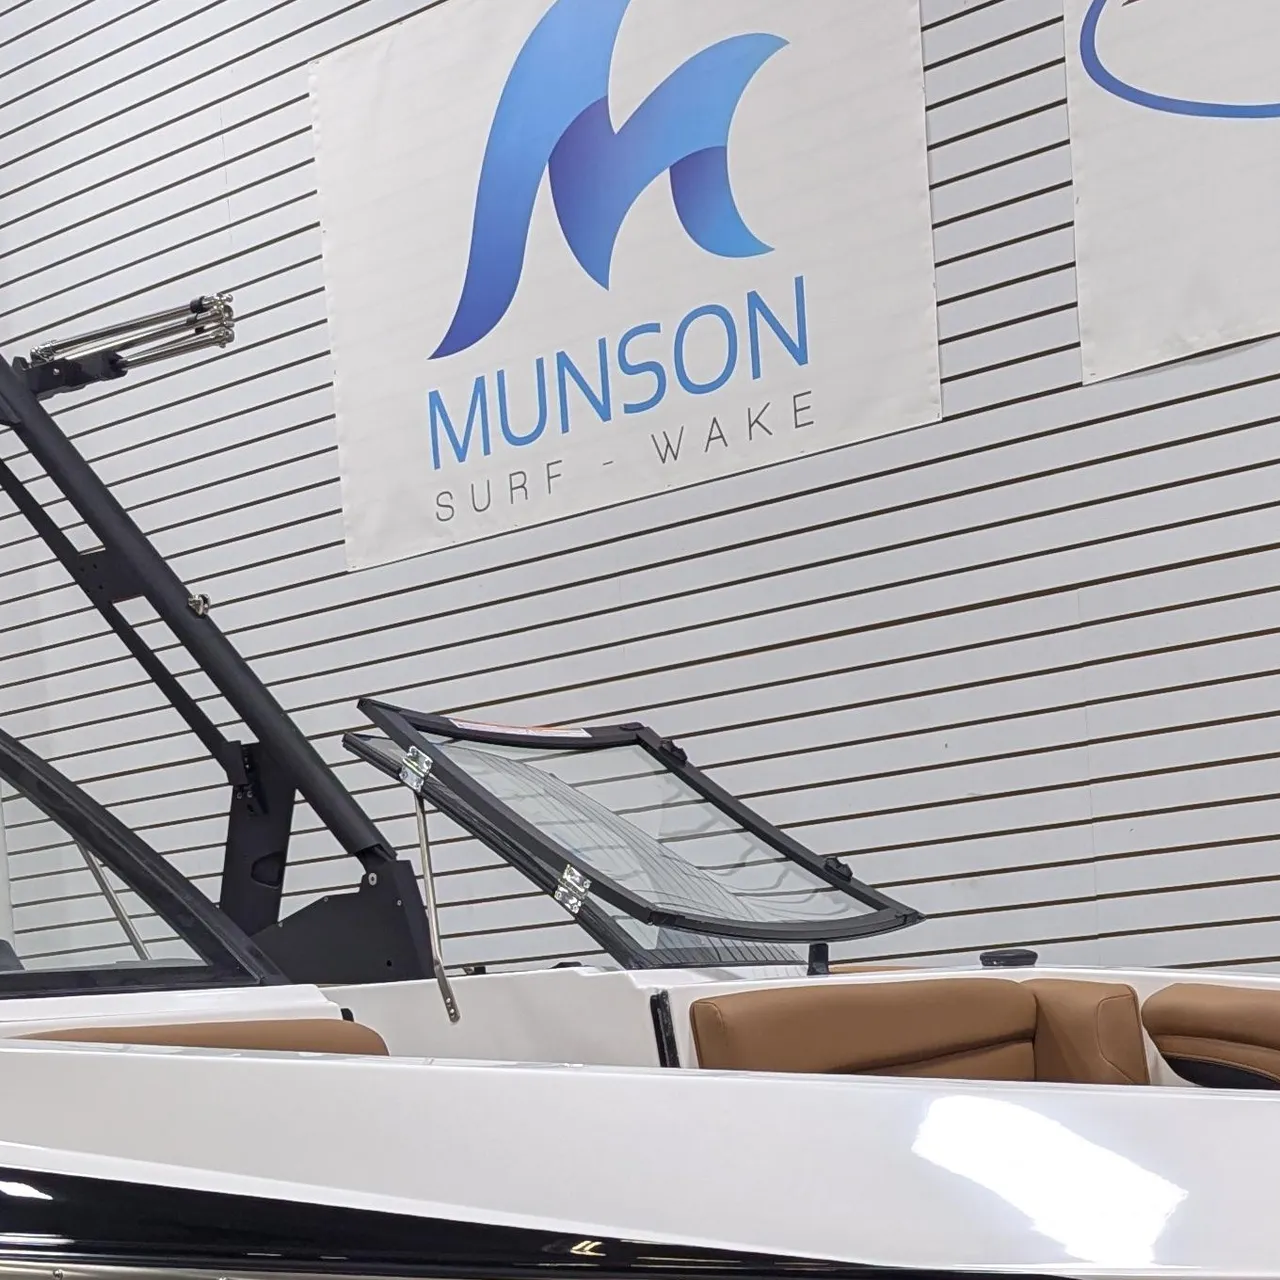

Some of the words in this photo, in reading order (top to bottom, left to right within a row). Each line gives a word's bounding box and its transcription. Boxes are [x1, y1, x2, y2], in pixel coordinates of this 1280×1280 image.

[427, 276, 810, 471] MUNSON
[435, 460, 563, 523] SURF
[650, 390, 815, 467] WAKE
